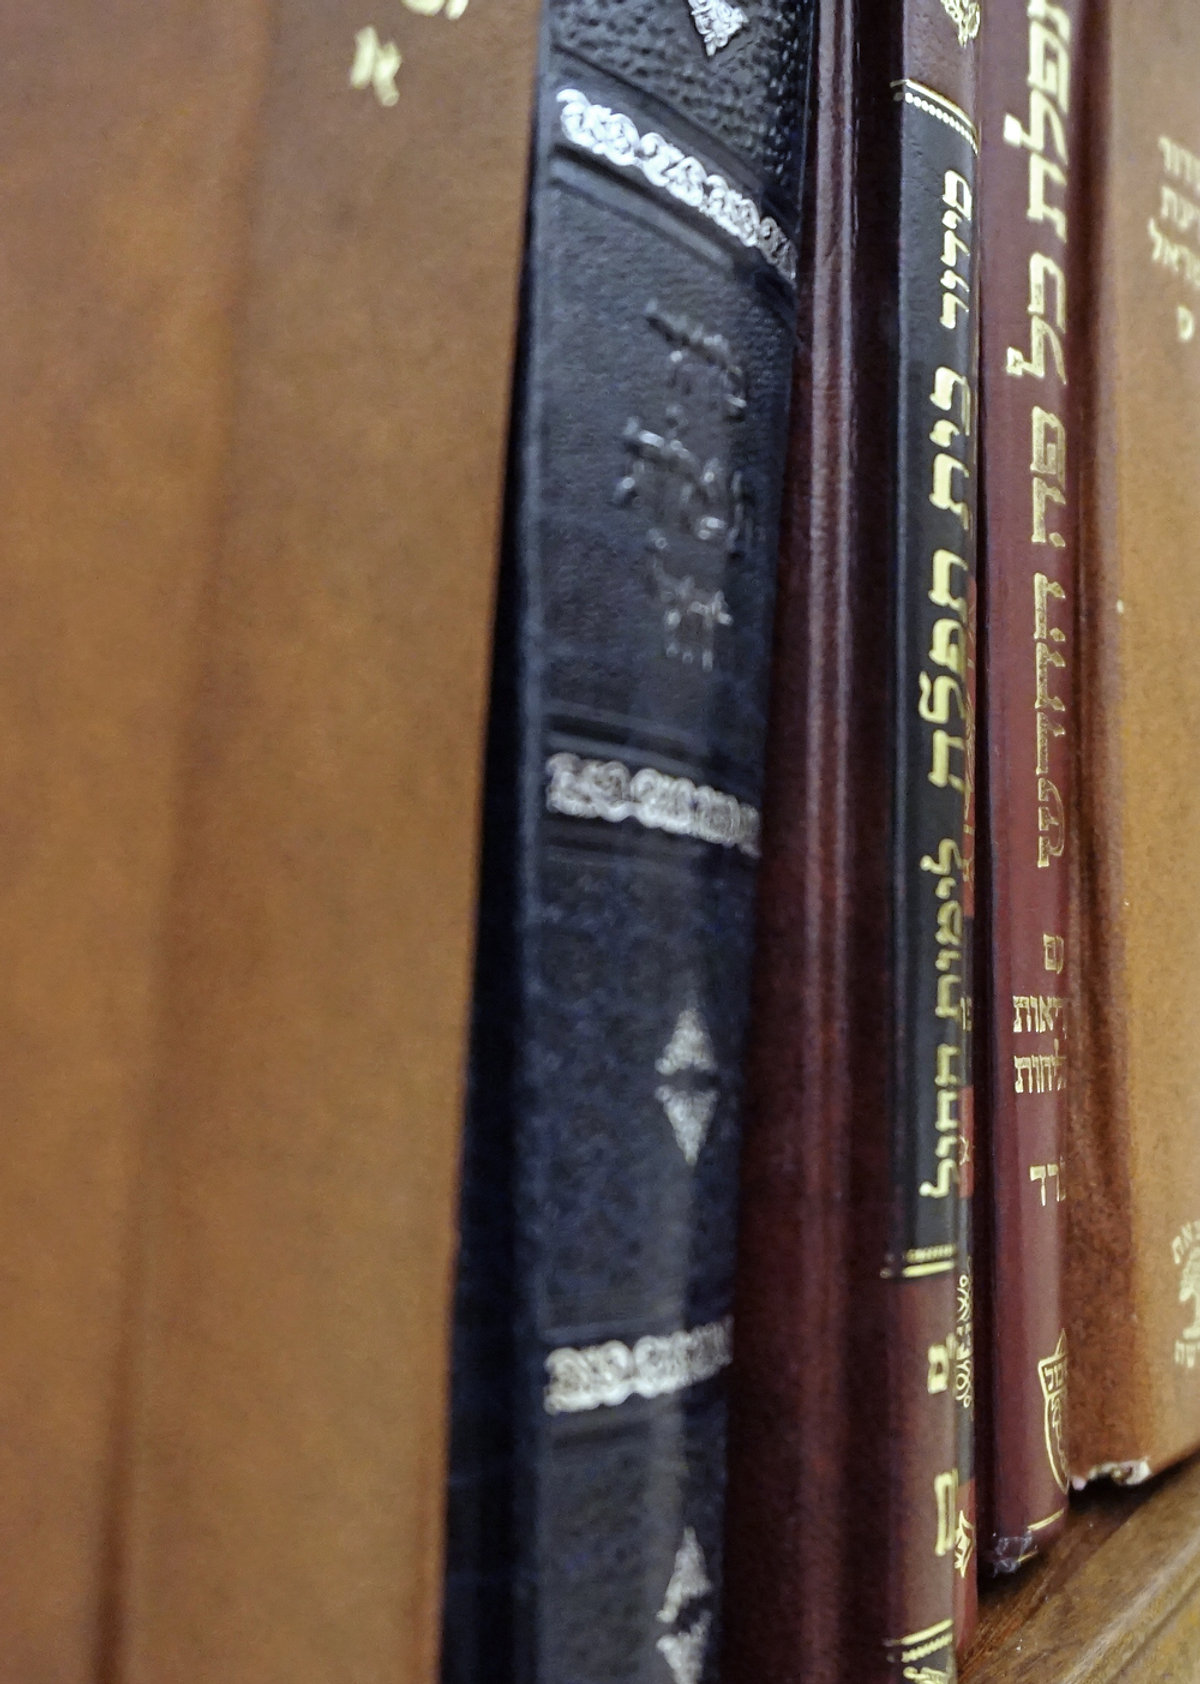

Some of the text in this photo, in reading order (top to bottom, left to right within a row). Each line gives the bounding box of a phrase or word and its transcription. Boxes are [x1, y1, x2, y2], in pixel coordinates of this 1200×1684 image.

[940, 170, 972, 328] סידור
[1006, 252, 1067, 385] כל
[929, 366, 971, 530] בית
[1030, 406, 1067, 547] פה
[920, 838, 963, 1018] לימות
